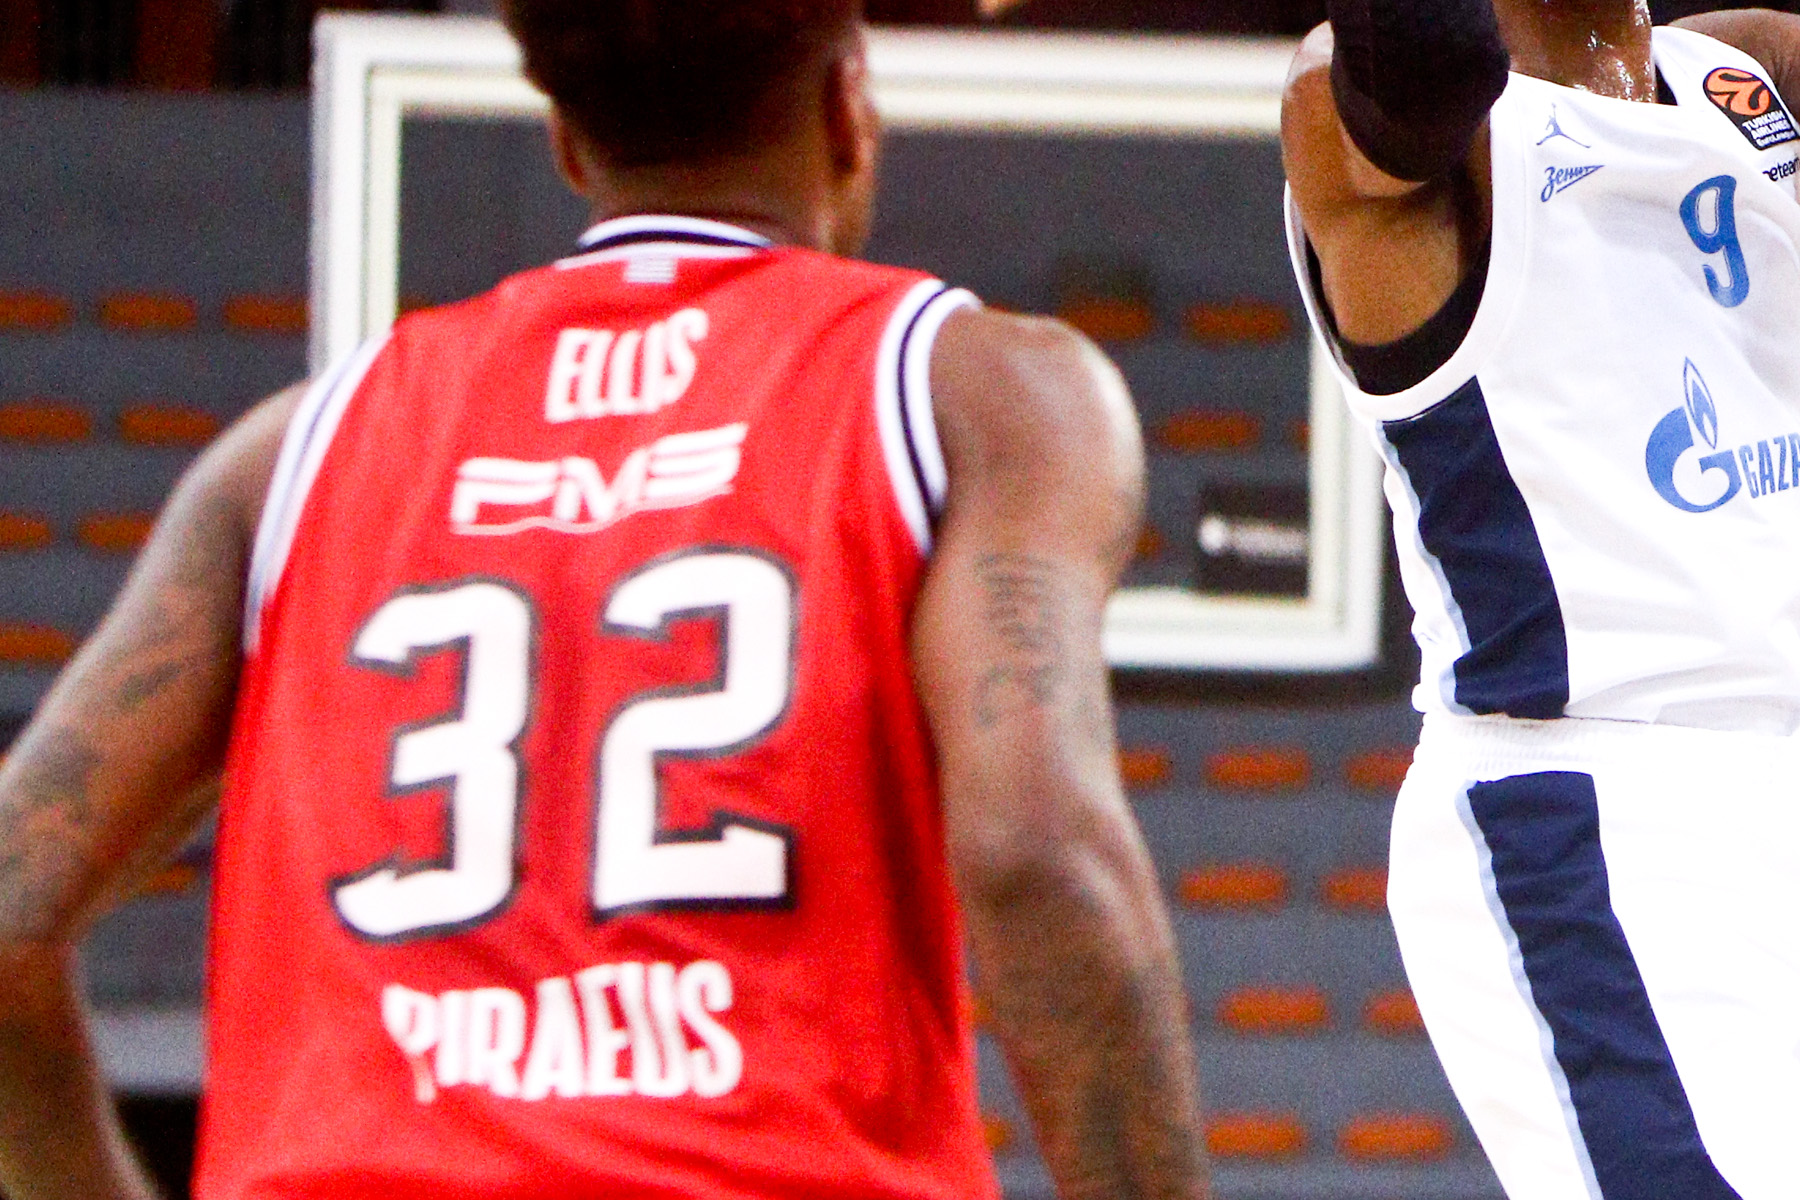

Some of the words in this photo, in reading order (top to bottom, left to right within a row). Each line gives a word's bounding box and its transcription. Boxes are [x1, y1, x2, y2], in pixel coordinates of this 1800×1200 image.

[1680, 174, 1750, 308] 9
[545, 307, 710, 424] ELLIS
[327, 545, 798, 942] 32
[382, 960, 743, 1104] PIRAEUS
